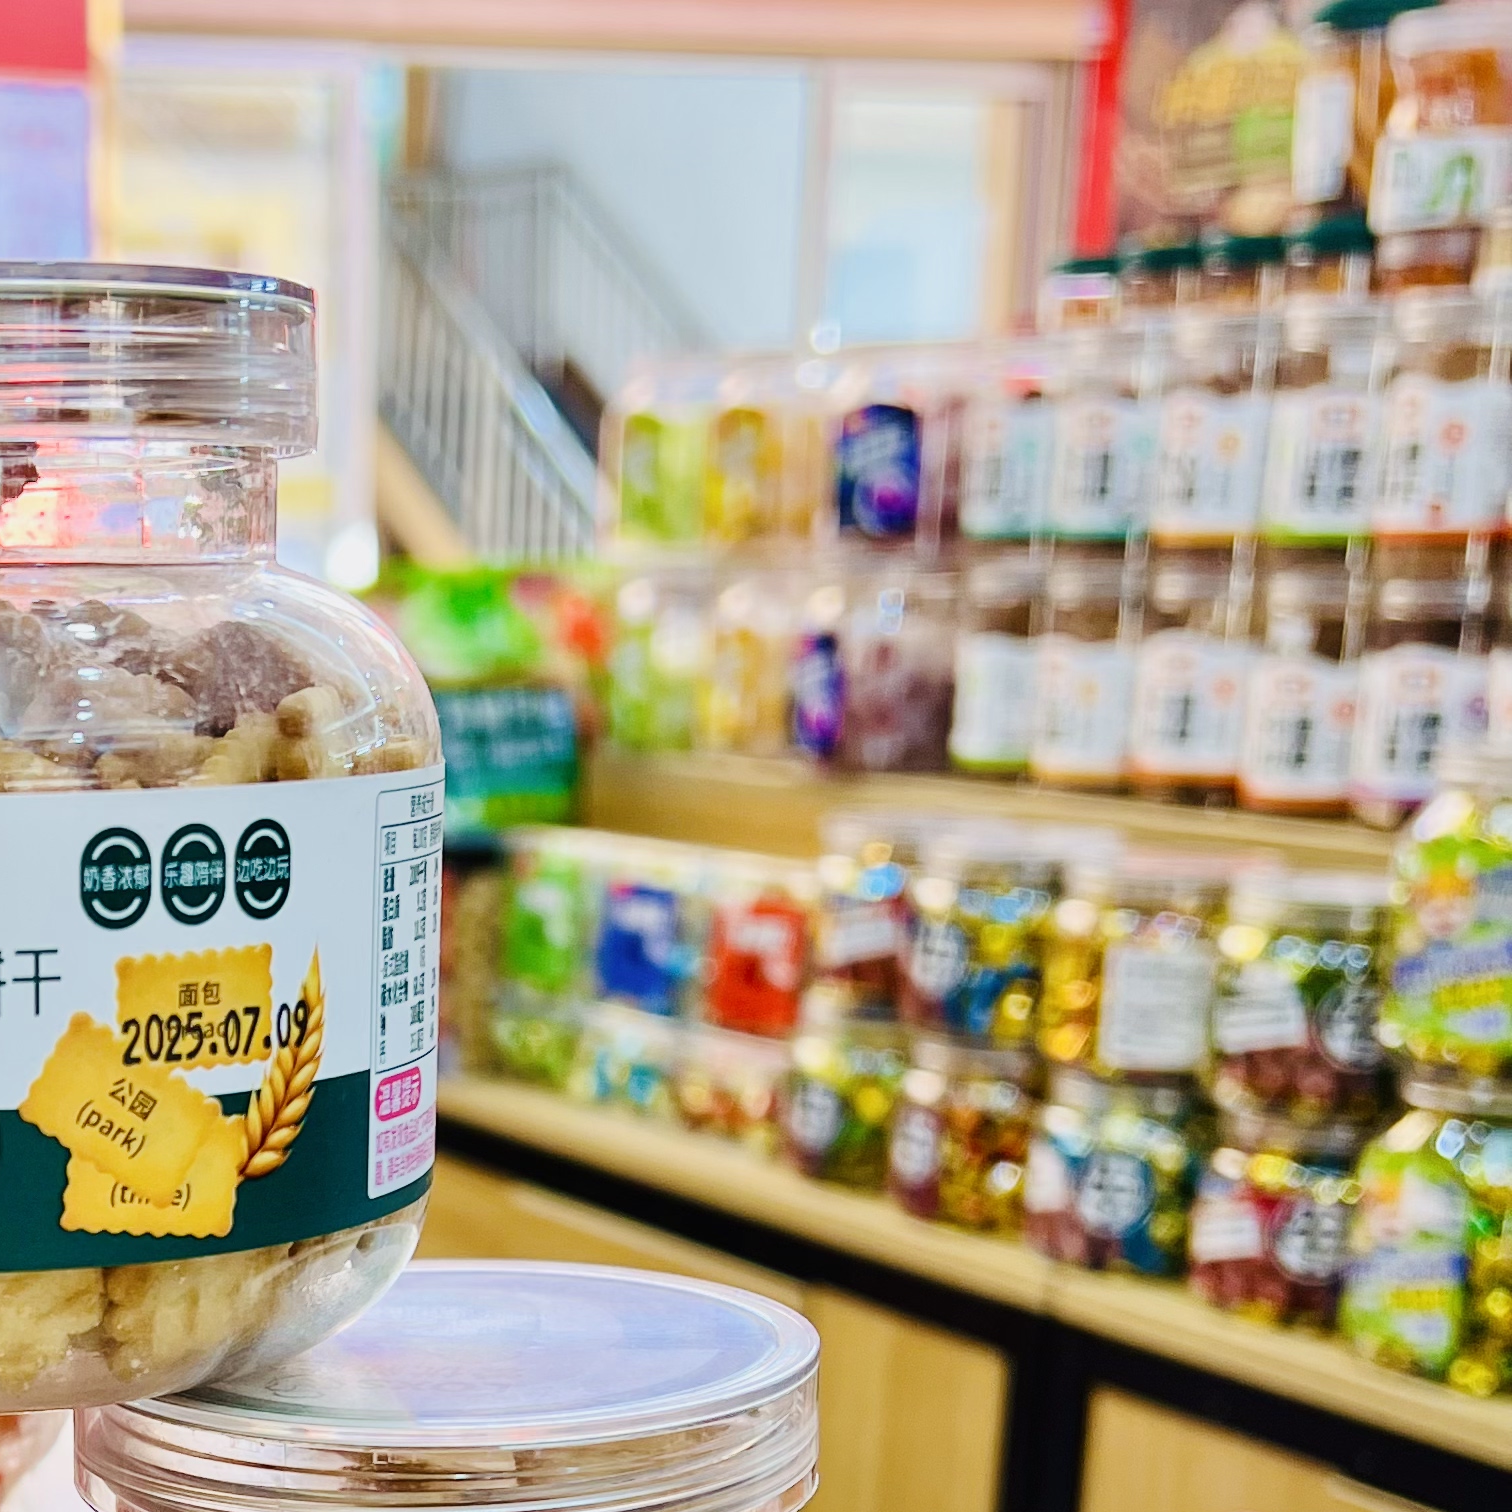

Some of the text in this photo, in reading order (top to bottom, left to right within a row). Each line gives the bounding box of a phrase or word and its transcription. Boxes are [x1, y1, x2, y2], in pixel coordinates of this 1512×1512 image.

[82, 862, 152, 893] 奶香浓郁
[163, 859, 225, 889] 乐趣陪伴
[235, 854, 289, 883] 边吃边玩
[178, 980, 221, 1008] 面包
[121, 998, 309, 1067] 2025.07.09
[108, 1076, 158, 1122] 公园
[74, 1099, 149, 1160] (park)
